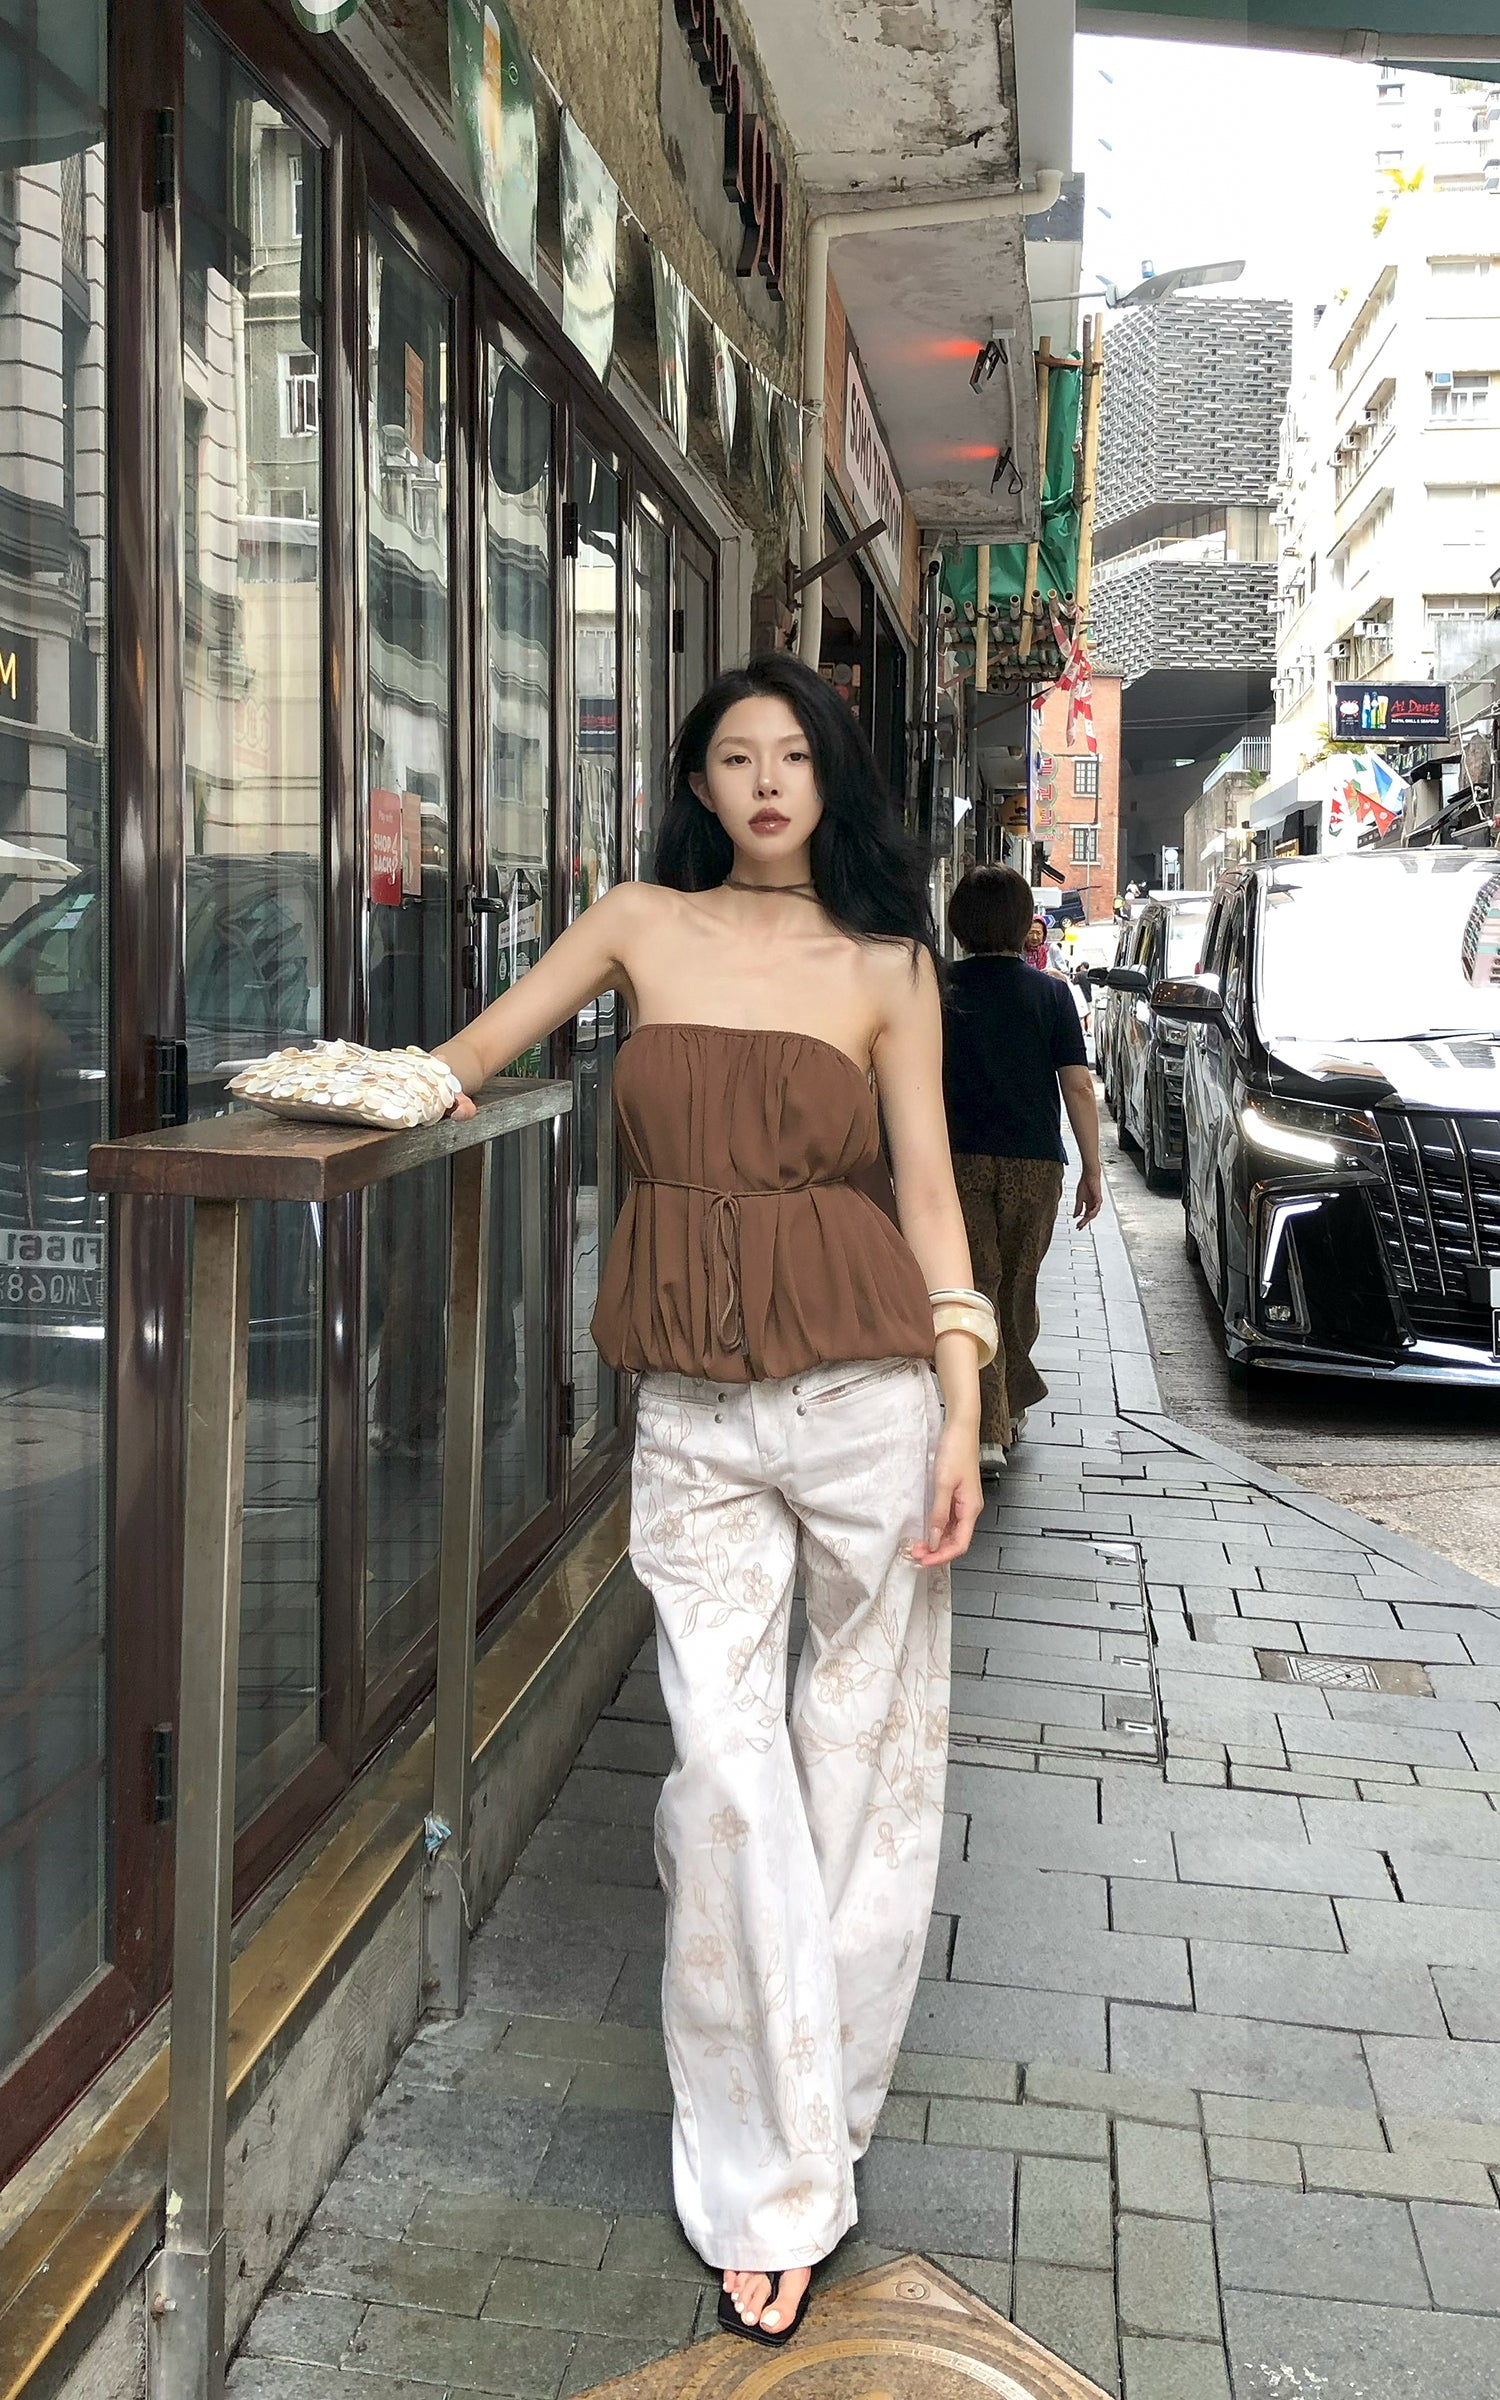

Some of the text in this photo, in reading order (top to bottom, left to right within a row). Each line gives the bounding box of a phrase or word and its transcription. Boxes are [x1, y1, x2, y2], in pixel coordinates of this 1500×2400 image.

[850, 382, 872, 490] SOHO
[1408, 699, 1440, 713] Dente
[373, 833, 392, 853] SHOP
[373, 854, 392, 874] BACK
